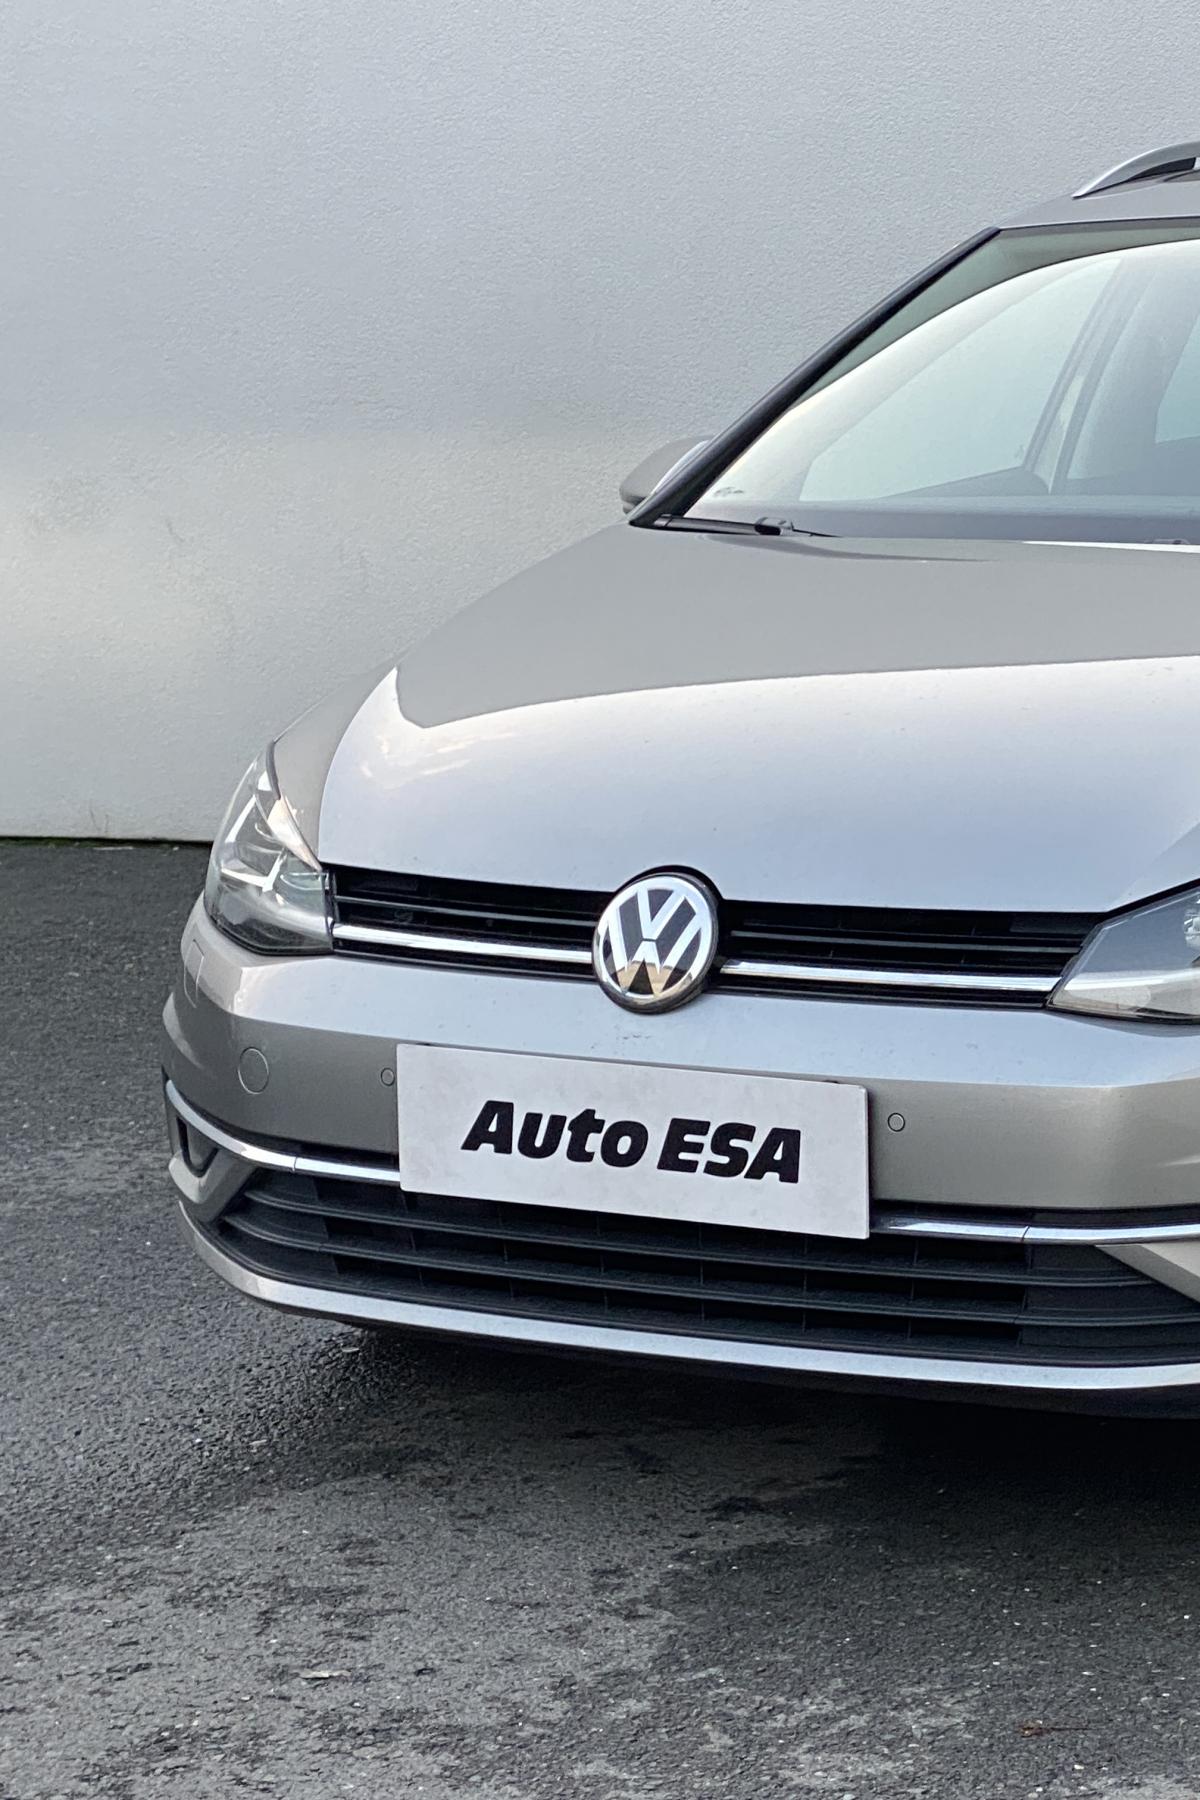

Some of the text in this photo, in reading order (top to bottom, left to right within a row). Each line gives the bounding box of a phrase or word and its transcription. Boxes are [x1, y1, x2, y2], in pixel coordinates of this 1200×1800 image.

[599, 877, 711, 998] VW
[460, 1100, 802, 1184] Auto ESA
